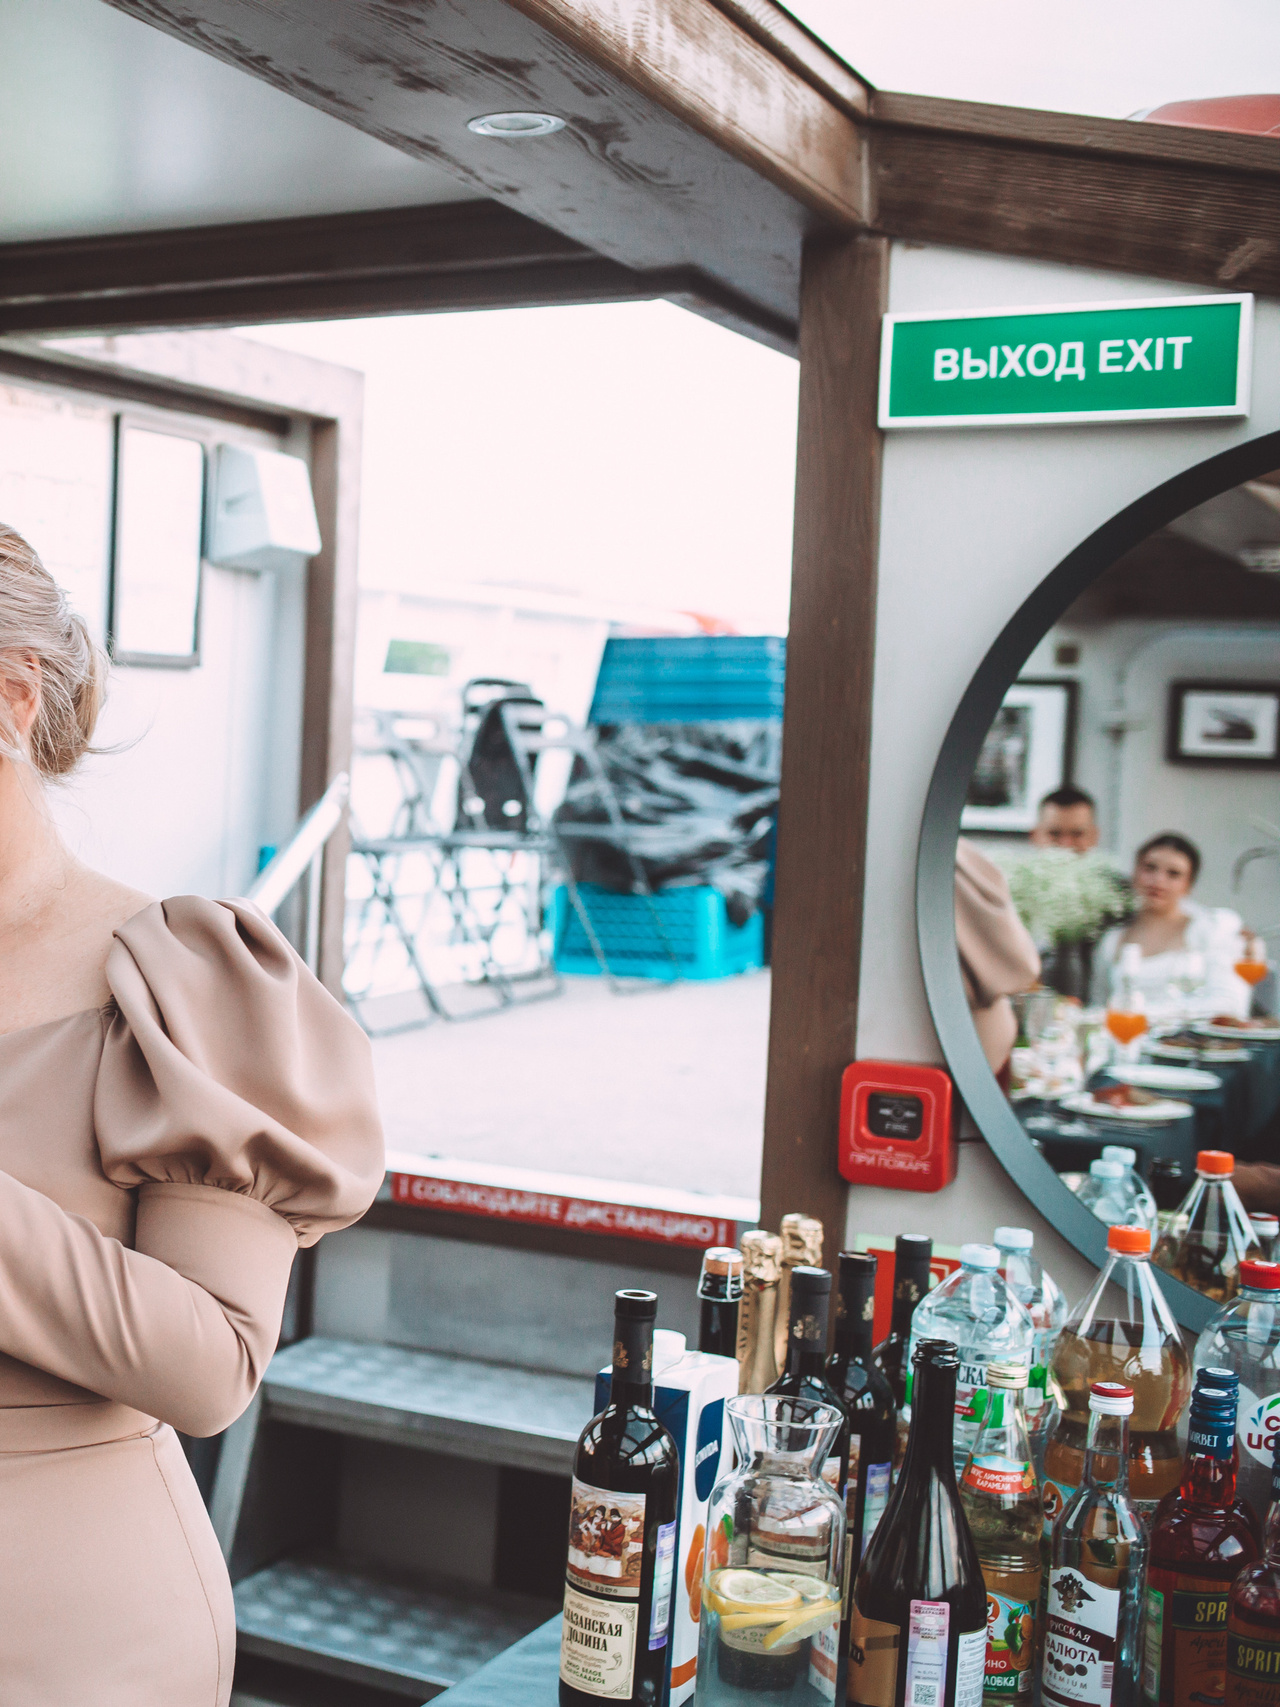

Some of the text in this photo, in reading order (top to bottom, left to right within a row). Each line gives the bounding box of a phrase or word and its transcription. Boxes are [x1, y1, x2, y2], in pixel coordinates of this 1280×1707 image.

[933, 336, 1192, 382] ВЫХОД EXIT
[849, 1151, 876, 1166] ПРИ
[877, 1156, 931, 1174] ПОЖАРЕ
[412, 1178, 562, 1221] СОБЛЮДАЙТЕ
[564, 1200, 716, 1243] ДИСТАНЦИЮ
[976, 1478, 1011, 1490] КАРАМЕЛИ
[984, 1472, 1022, 1483] ЛИМОННОЙ
[564, 1606, 623, 1637] ЛАЗАНСКАЯ
[1195, 1601, 1228, 1622] SPR
[567, 1625, 608, 1652] ДОЛИНА
[1049, 1620, 1091, 1643] РУССКАЯ
[1046, 1634, 1097, 1665] ВАЛЮТА
[1237, 1645, 1280, 1674] SPRIT
[582, 1667, 602, 1678] БЕЛОЕ
[985, 1659, 1007, 1669] ИНО
[1045, 1668, 1088, 1690] PREMIUM
